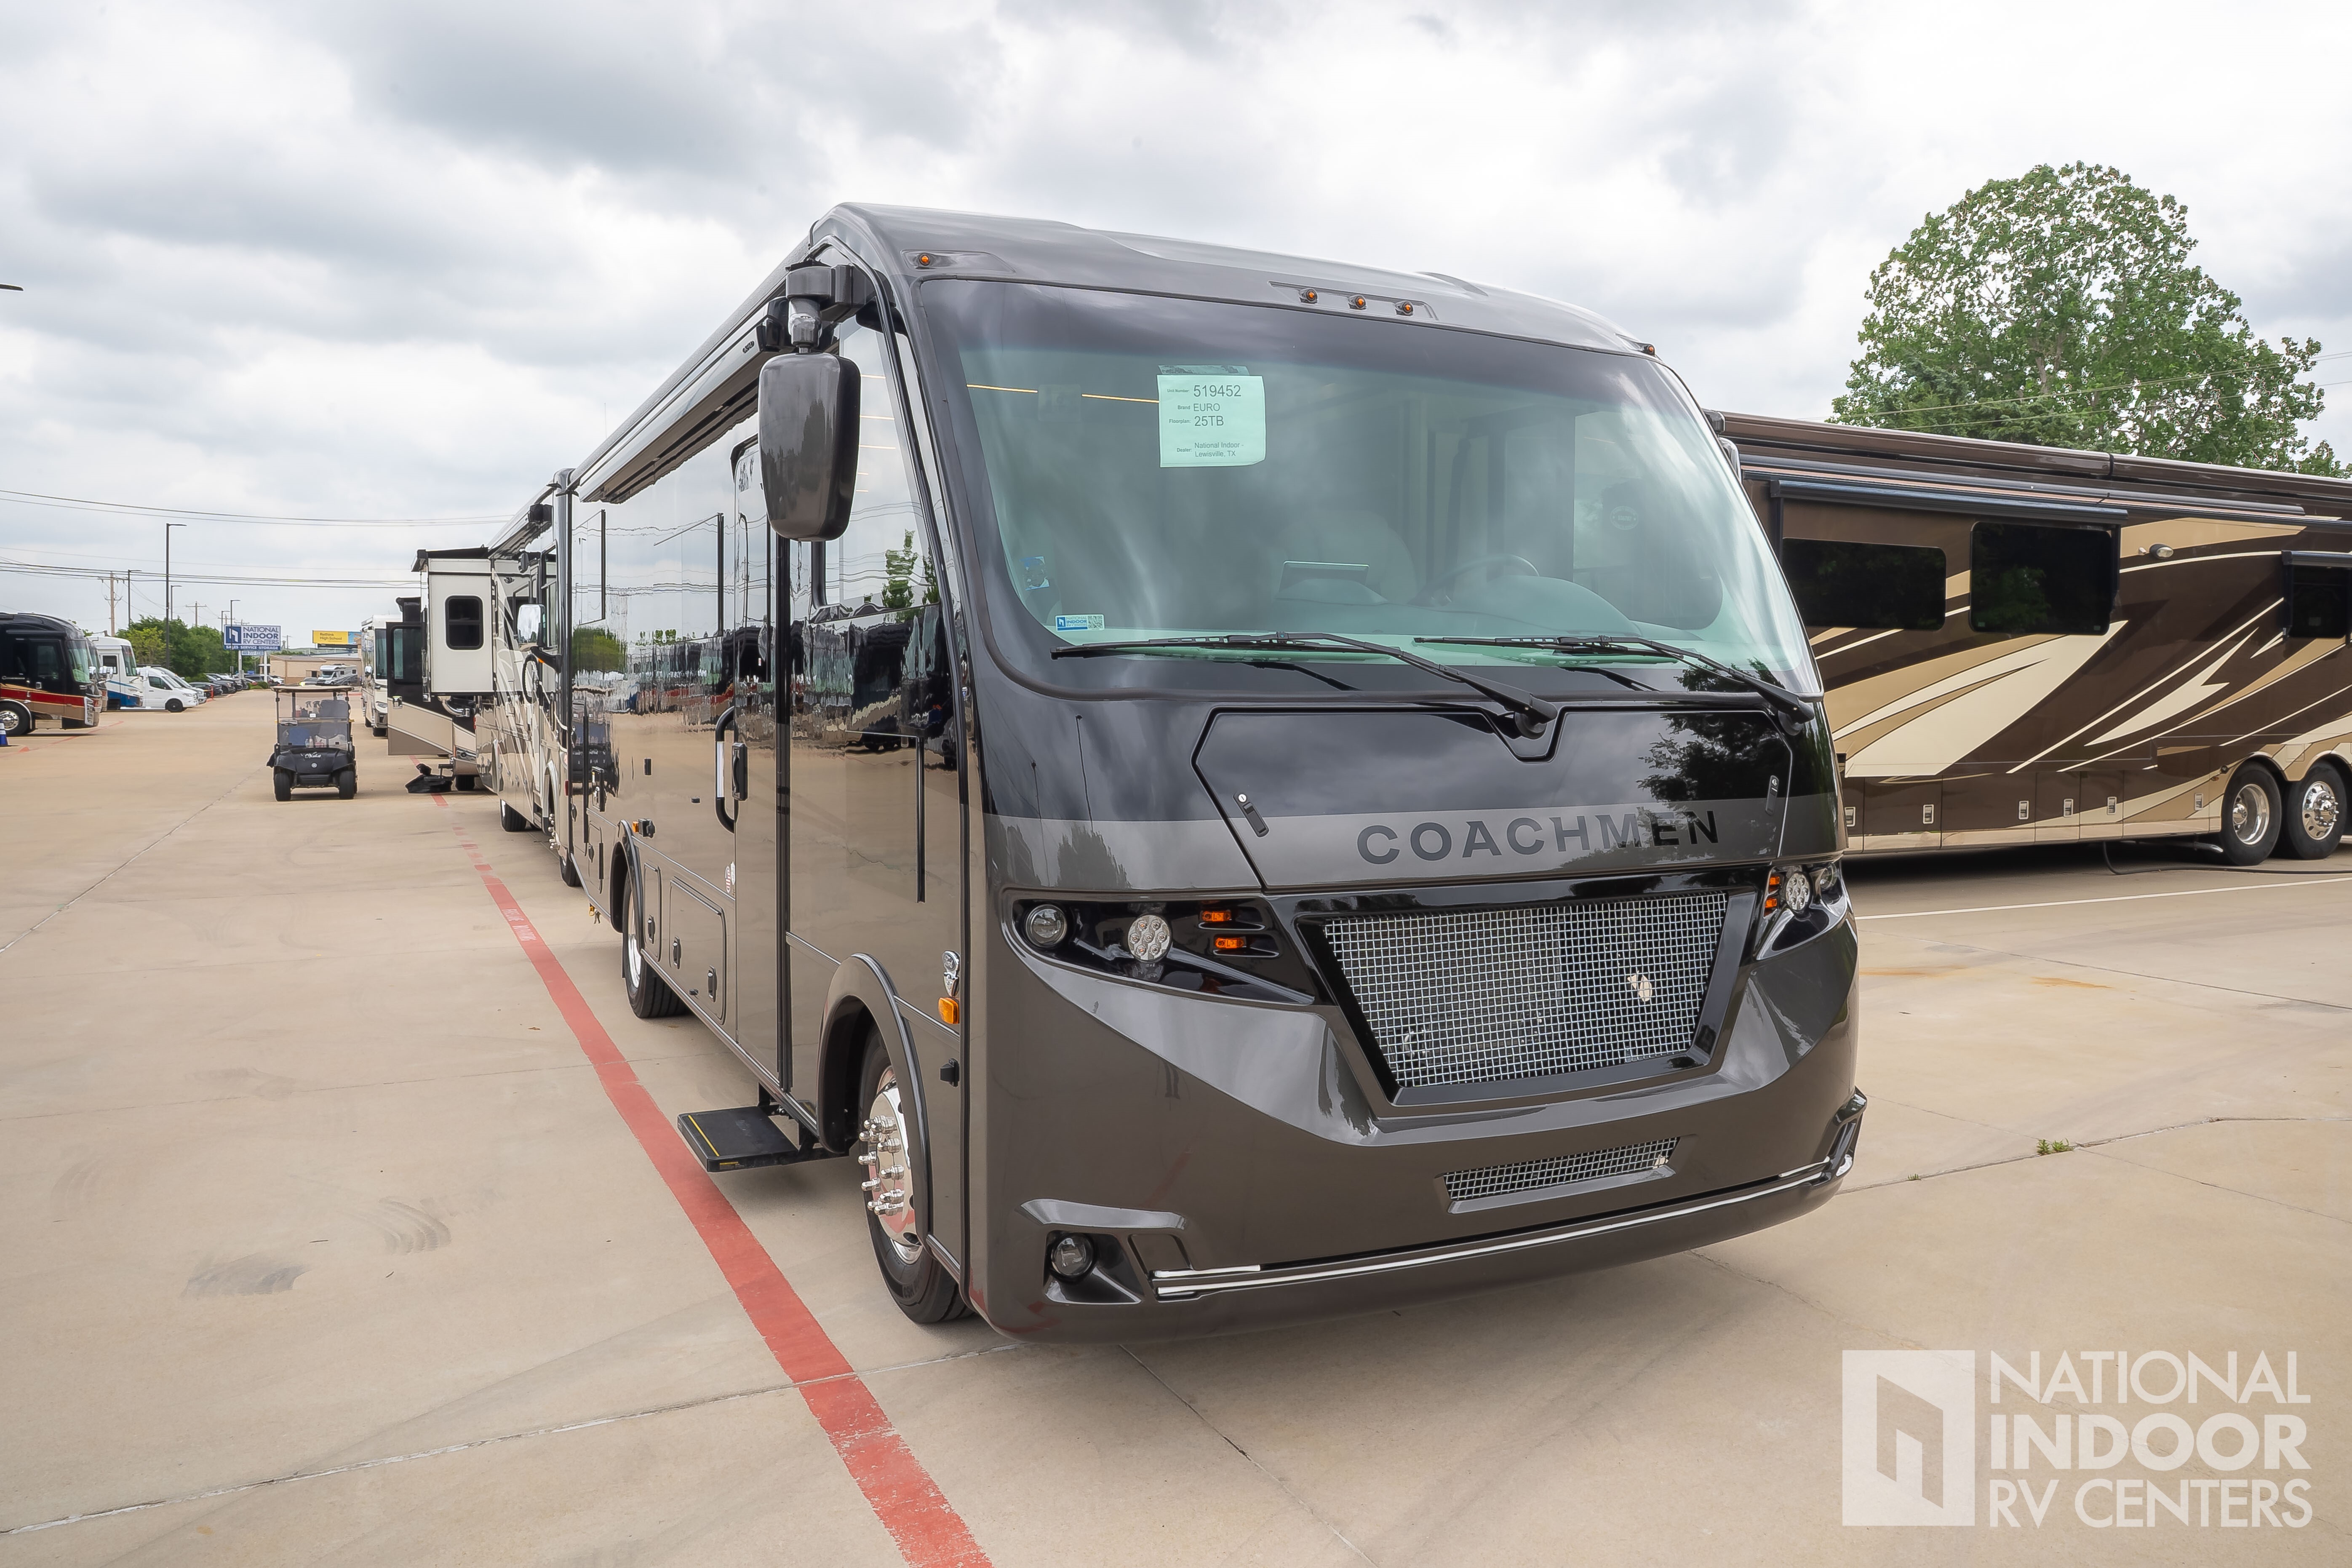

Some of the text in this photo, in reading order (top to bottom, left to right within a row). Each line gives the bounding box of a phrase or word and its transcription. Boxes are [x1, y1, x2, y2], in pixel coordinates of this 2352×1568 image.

[1193, 385, 1241, 397] 519452
[1193, 403, 1220, 411] EURO
[1194, 415, 1224, 426] 25TB
[1356, 809, 1718, 865] COACHMEN
